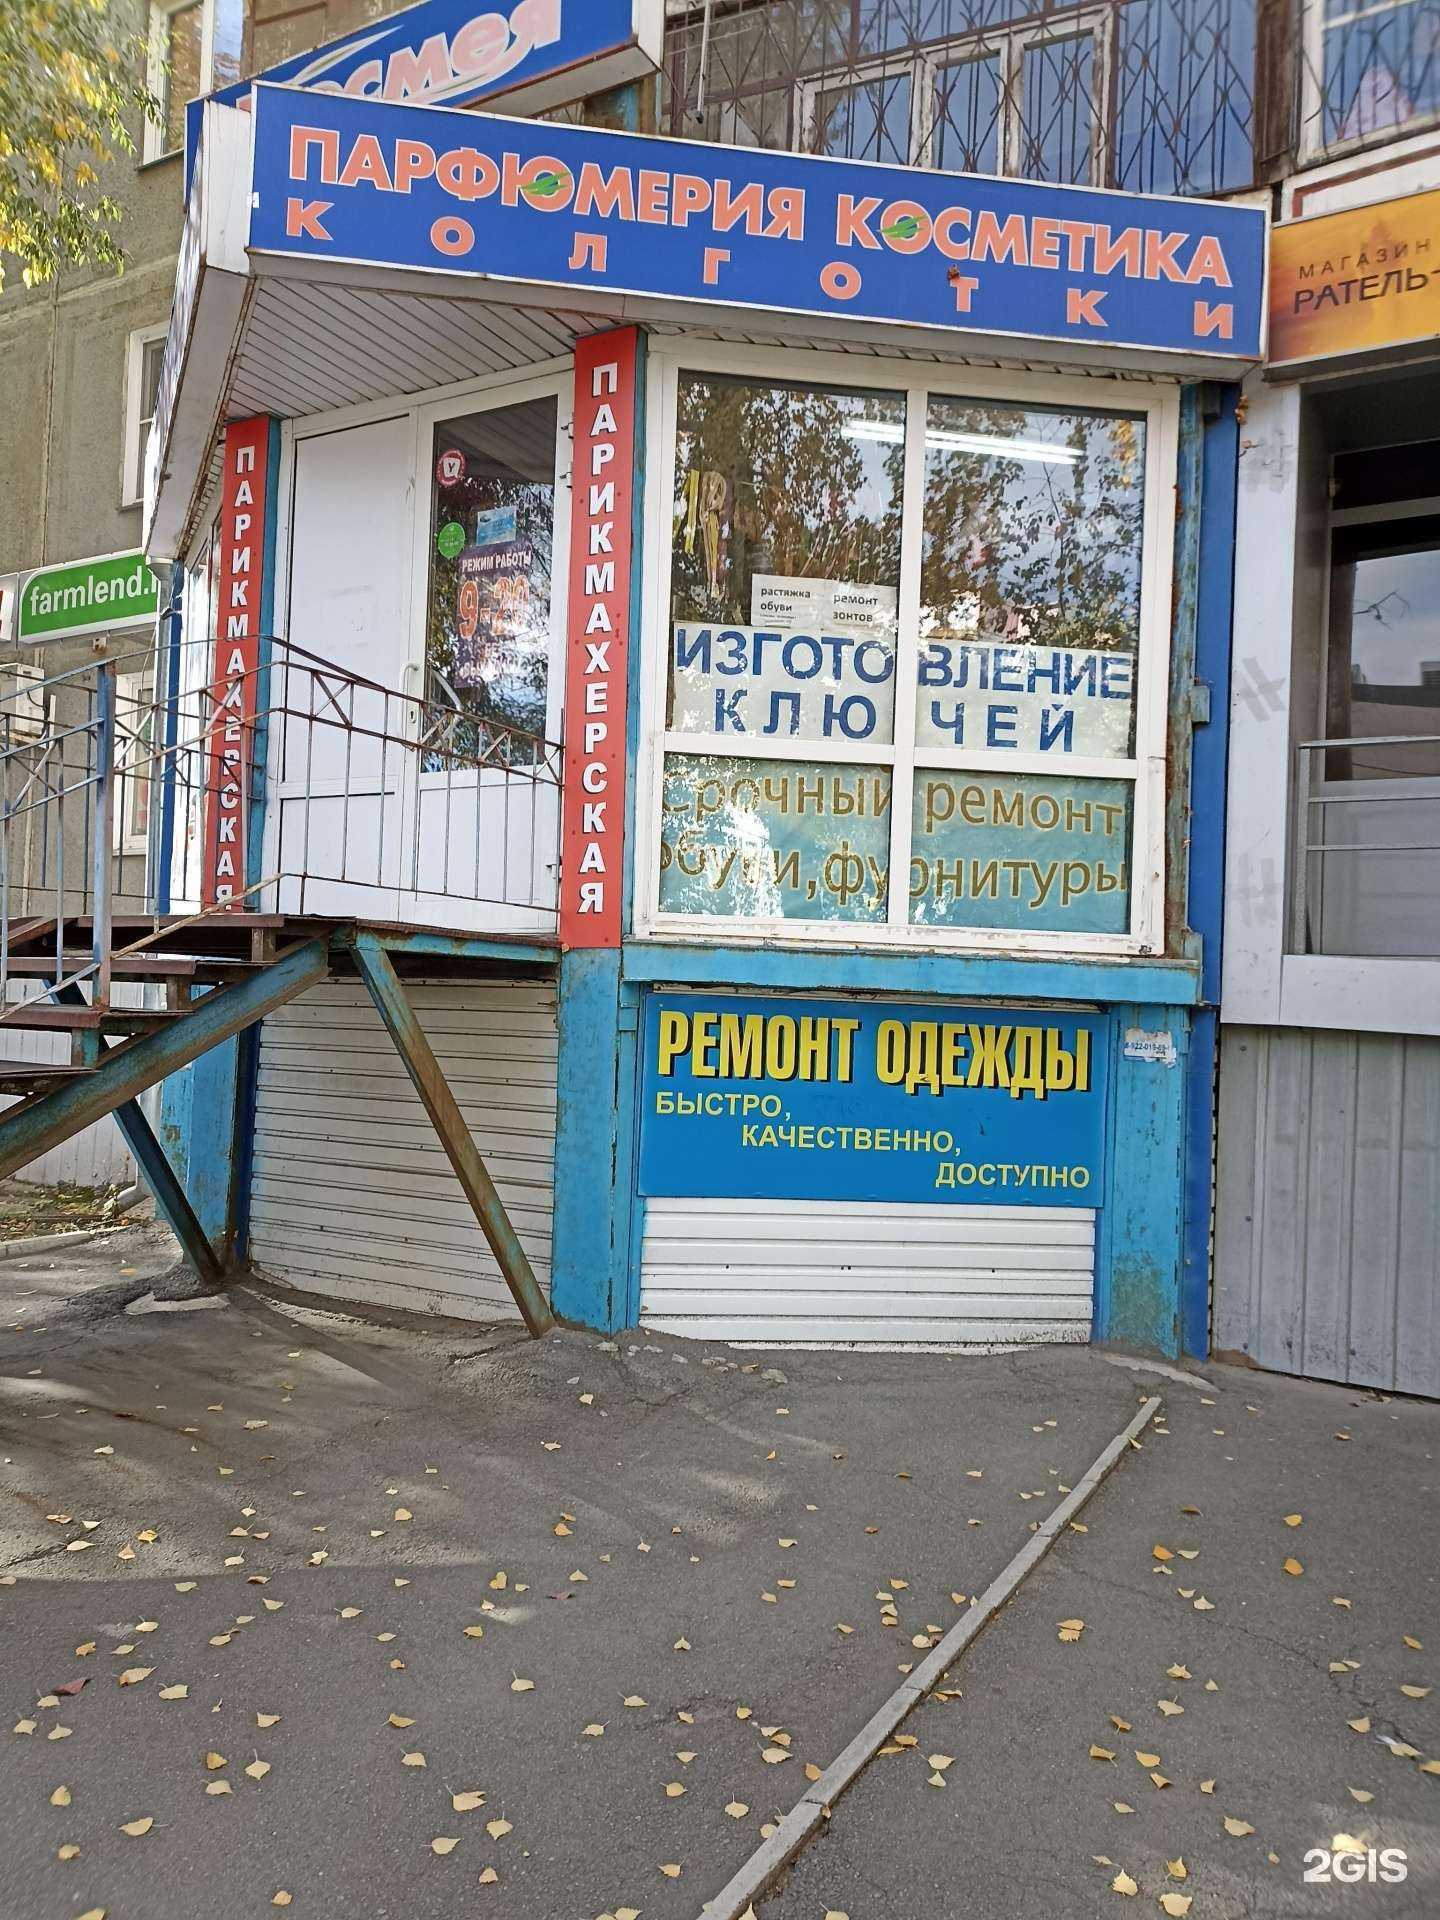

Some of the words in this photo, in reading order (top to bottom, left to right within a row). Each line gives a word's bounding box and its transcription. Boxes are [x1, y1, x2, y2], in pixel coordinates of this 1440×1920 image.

[289, 124, 806, 242] ПАРФЮМЕРИЯ
[835, 193, 1233, 288] КОСМЕТИКА
[1299, 238, 1431, 280] МАГАЗИН
[462, 556, 494, 573] РЕЖИМ
[495, 551, 533, 568] РАБОТЫ
[760, 586, 811, 600] растяжка
[760, 601, 792, 612] обуви
[833, 593, 878, 606] ремонт
[832, 611, 873, 623] зонтов
[577, 364, 618, 914] ПАРИКМАХЕРСКАЯ
[215, 445, 254, 910] ПАРИКМАХЕРСКАЯ
[926, 781, 1123, 835] ремонт
[658, 1010, 861, 1083] РЕМОНТ
[876, 1019, 1091, 1099] ОДЕЖДЫ
[656, 1091, 792, 1121] БЫСТРО,
[742, 1124, 961, 1156] КАЧЕСТВЕННО,
[935, 1163, 1091, 1189] ДОСТУПНО
